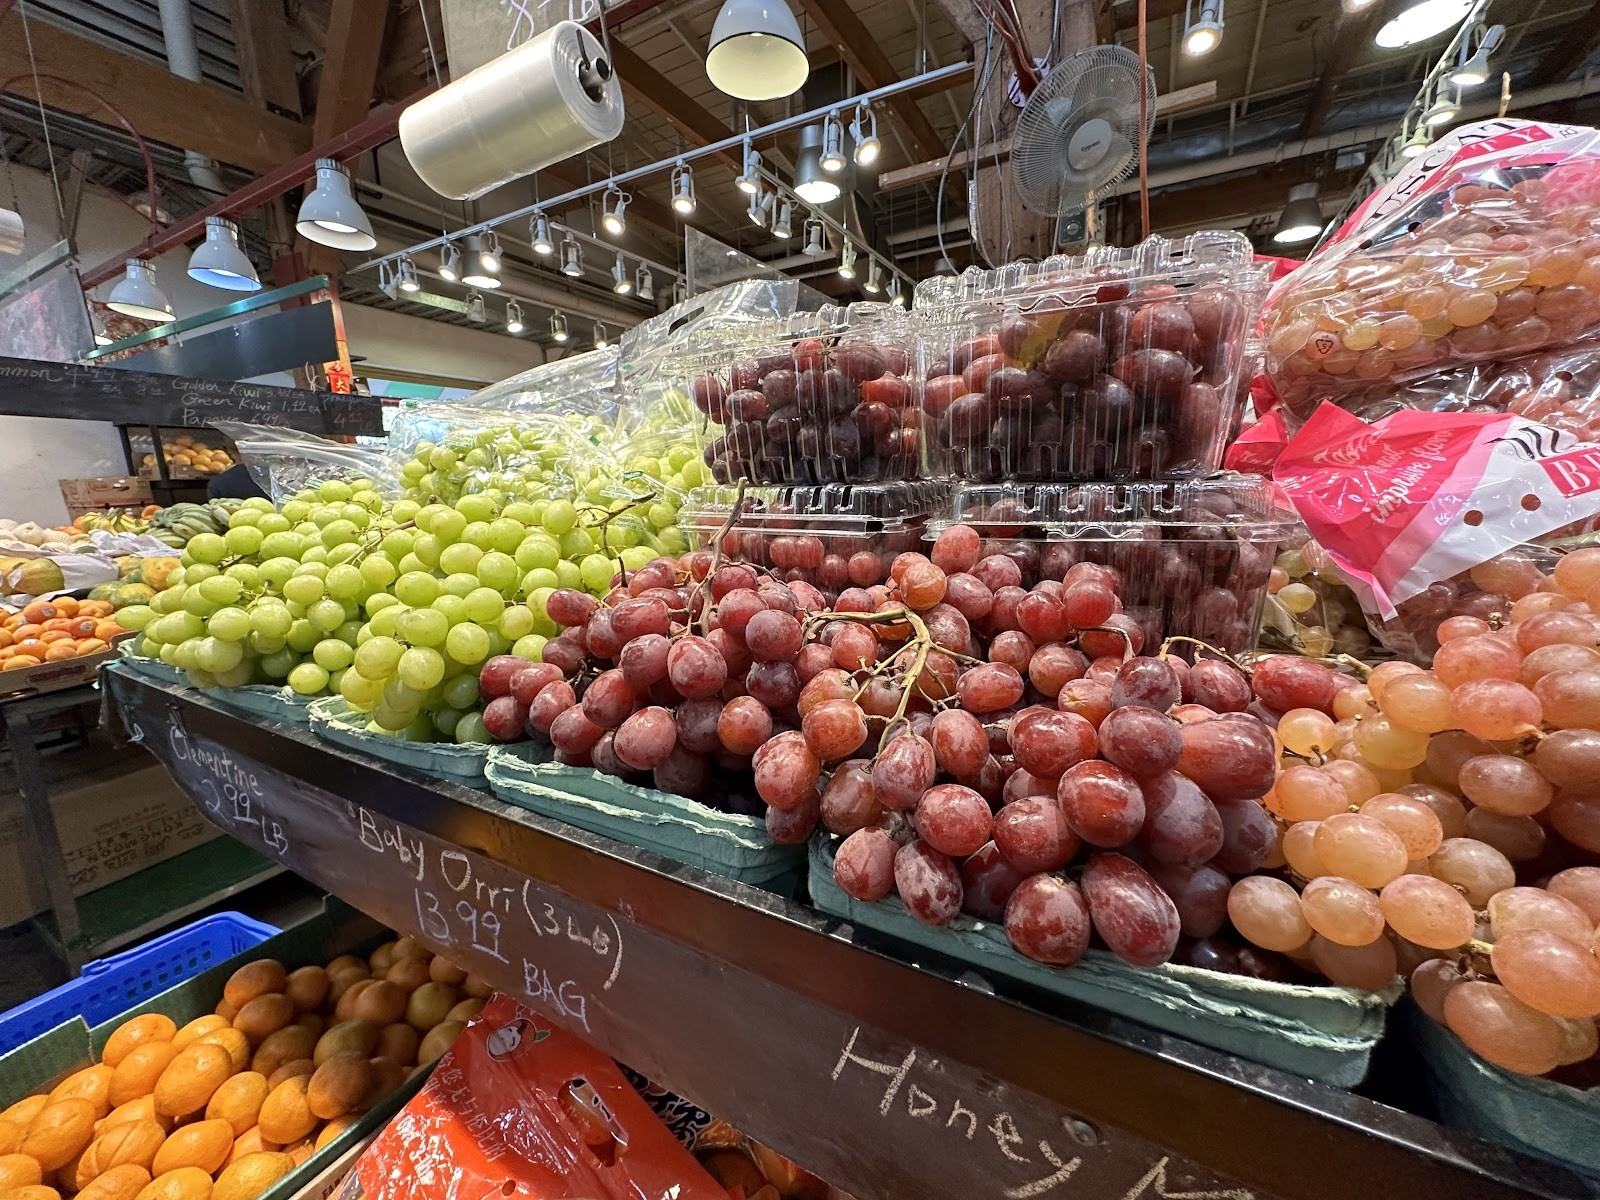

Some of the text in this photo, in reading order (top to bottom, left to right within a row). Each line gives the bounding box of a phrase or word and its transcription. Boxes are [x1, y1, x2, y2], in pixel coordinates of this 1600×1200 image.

[171, 379, 221, 393] Golden
[229, 382, 260, 398] Kiwi
[181, 392, 235, 407] Green
[238, 397, 271, 411] Kiwi
[170, 726, 264, 796] Clementine
[261, 815, 289, 856] LB
[358, 806, 425, 882] Baby
[440, 849, 515, 913] Orri
[523, 957, 591, 1033] BAG
[831, 1026, 1083, 1199] Honey
